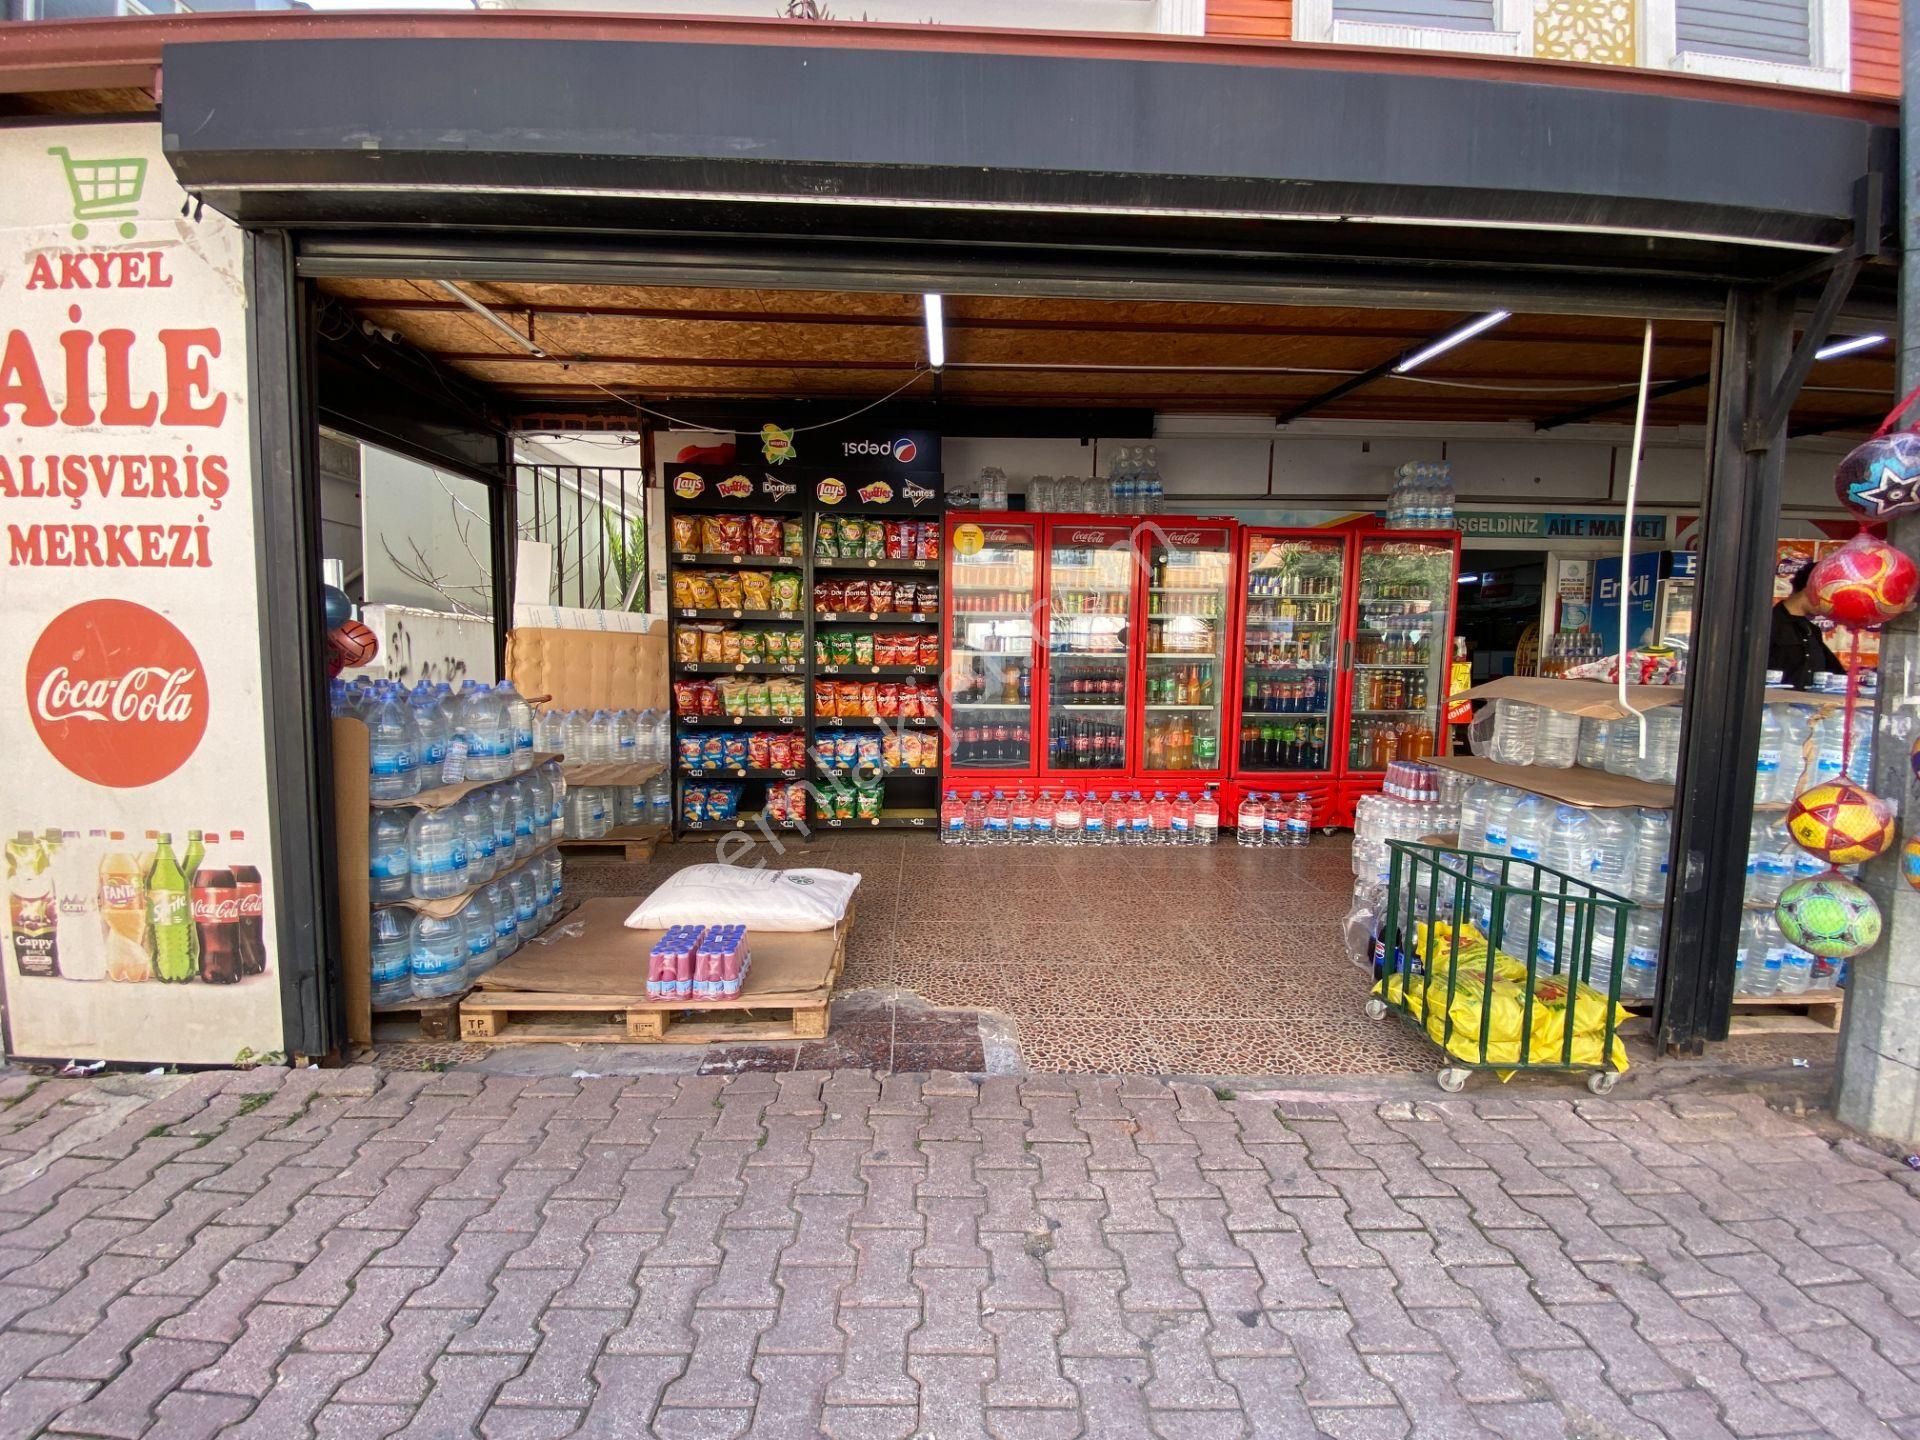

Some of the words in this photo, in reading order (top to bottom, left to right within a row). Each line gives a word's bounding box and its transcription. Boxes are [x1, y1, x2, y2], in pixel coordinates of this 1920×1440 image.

[25, 252, 173, 290] AKYEL
[0, 304, 227, 428] AİLE
[844, 440, 891, 456] pepsi
[0, 444, 230, 510] ALIŞVERİŞ
[719, 480, 754, 495] Ruffles
[763, 481, 797, 493] Doritos
[860, 486, 893, 501] Ruffles
[903, 488, 935, 499] Doritos
[1548, 515, 1583, 537] AİLE
[8, 514, 213, 568] MERKEZİ
[1600, 575, 1650, 598] Erkli
[38, 666, 197, 722] Coca-Cola
[16, 936, 53, 950] Cappy
